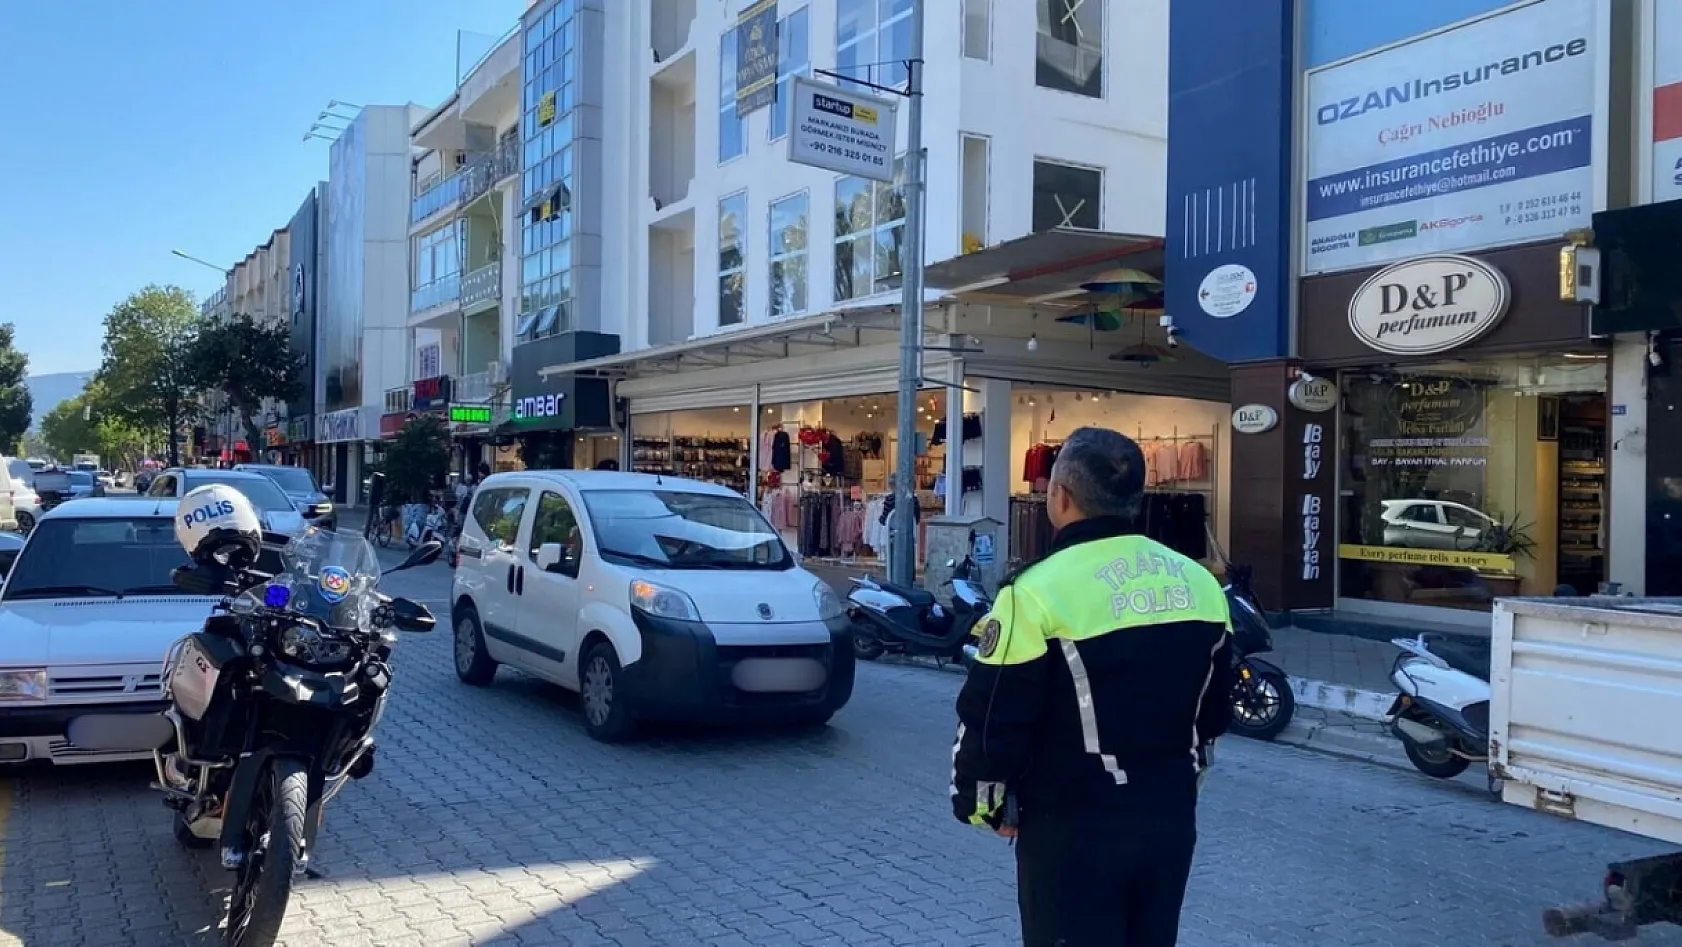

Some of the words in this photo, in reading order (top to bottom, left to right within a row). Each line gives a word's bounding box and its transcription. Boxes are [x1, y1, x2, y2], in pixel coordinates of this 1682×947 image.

[815, 97, 850, 115] startup
[850, 127, 879, 139] BURADA
[1378, 123, 1422, 147] Çağrı
[1428, 102, 1505, 132] Nebioğlu
[827, 144, 842, 156] 216
[1320, 129, 1573, 198] www.insurancefethiye.com
[1361, 166, 1516, 208] insurancefethiye@hotmail.com
[1311, 231, 1356, 246] ANADOLU
[1376, 310, 1477, 338] perfumum
[1304, 383, 1328, 397] D&P
[1360, 548, 1385, 560] Every
[1388, 550, 1428, 563] perfume
[1429, 553, 1449, 563] tells
[1463, 555, 1488, 565] story
